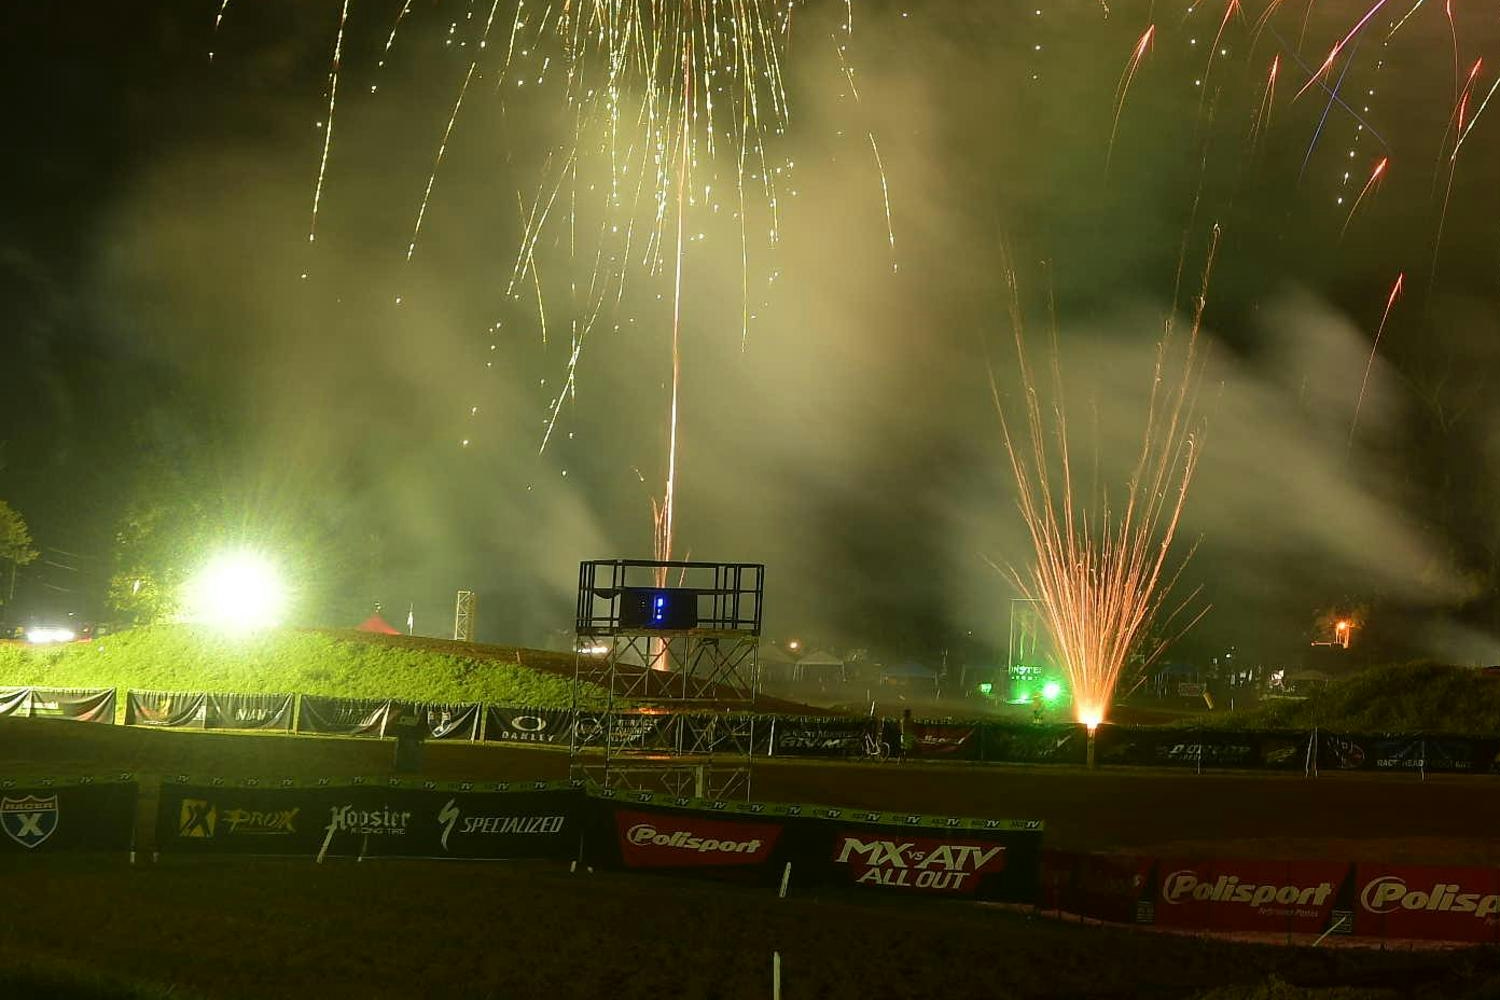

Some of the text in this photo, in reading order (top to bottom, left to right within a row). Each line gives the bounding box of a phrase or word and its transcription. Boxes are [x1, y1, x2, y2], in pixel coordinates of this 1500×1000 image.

[16, 813, 45, 837] X
[328, 801, 410, 831] Hoosier
[460, 816, 565, 833] SPECIALIZED
[632, 826, 761, 853] Polisport
[835, 837, 914, 868] MX
[914, 845, 1007, 872] ATV
[856, 868, 970, 890] ALL OUT
[1168, 872, 1332, 907] Polisport
